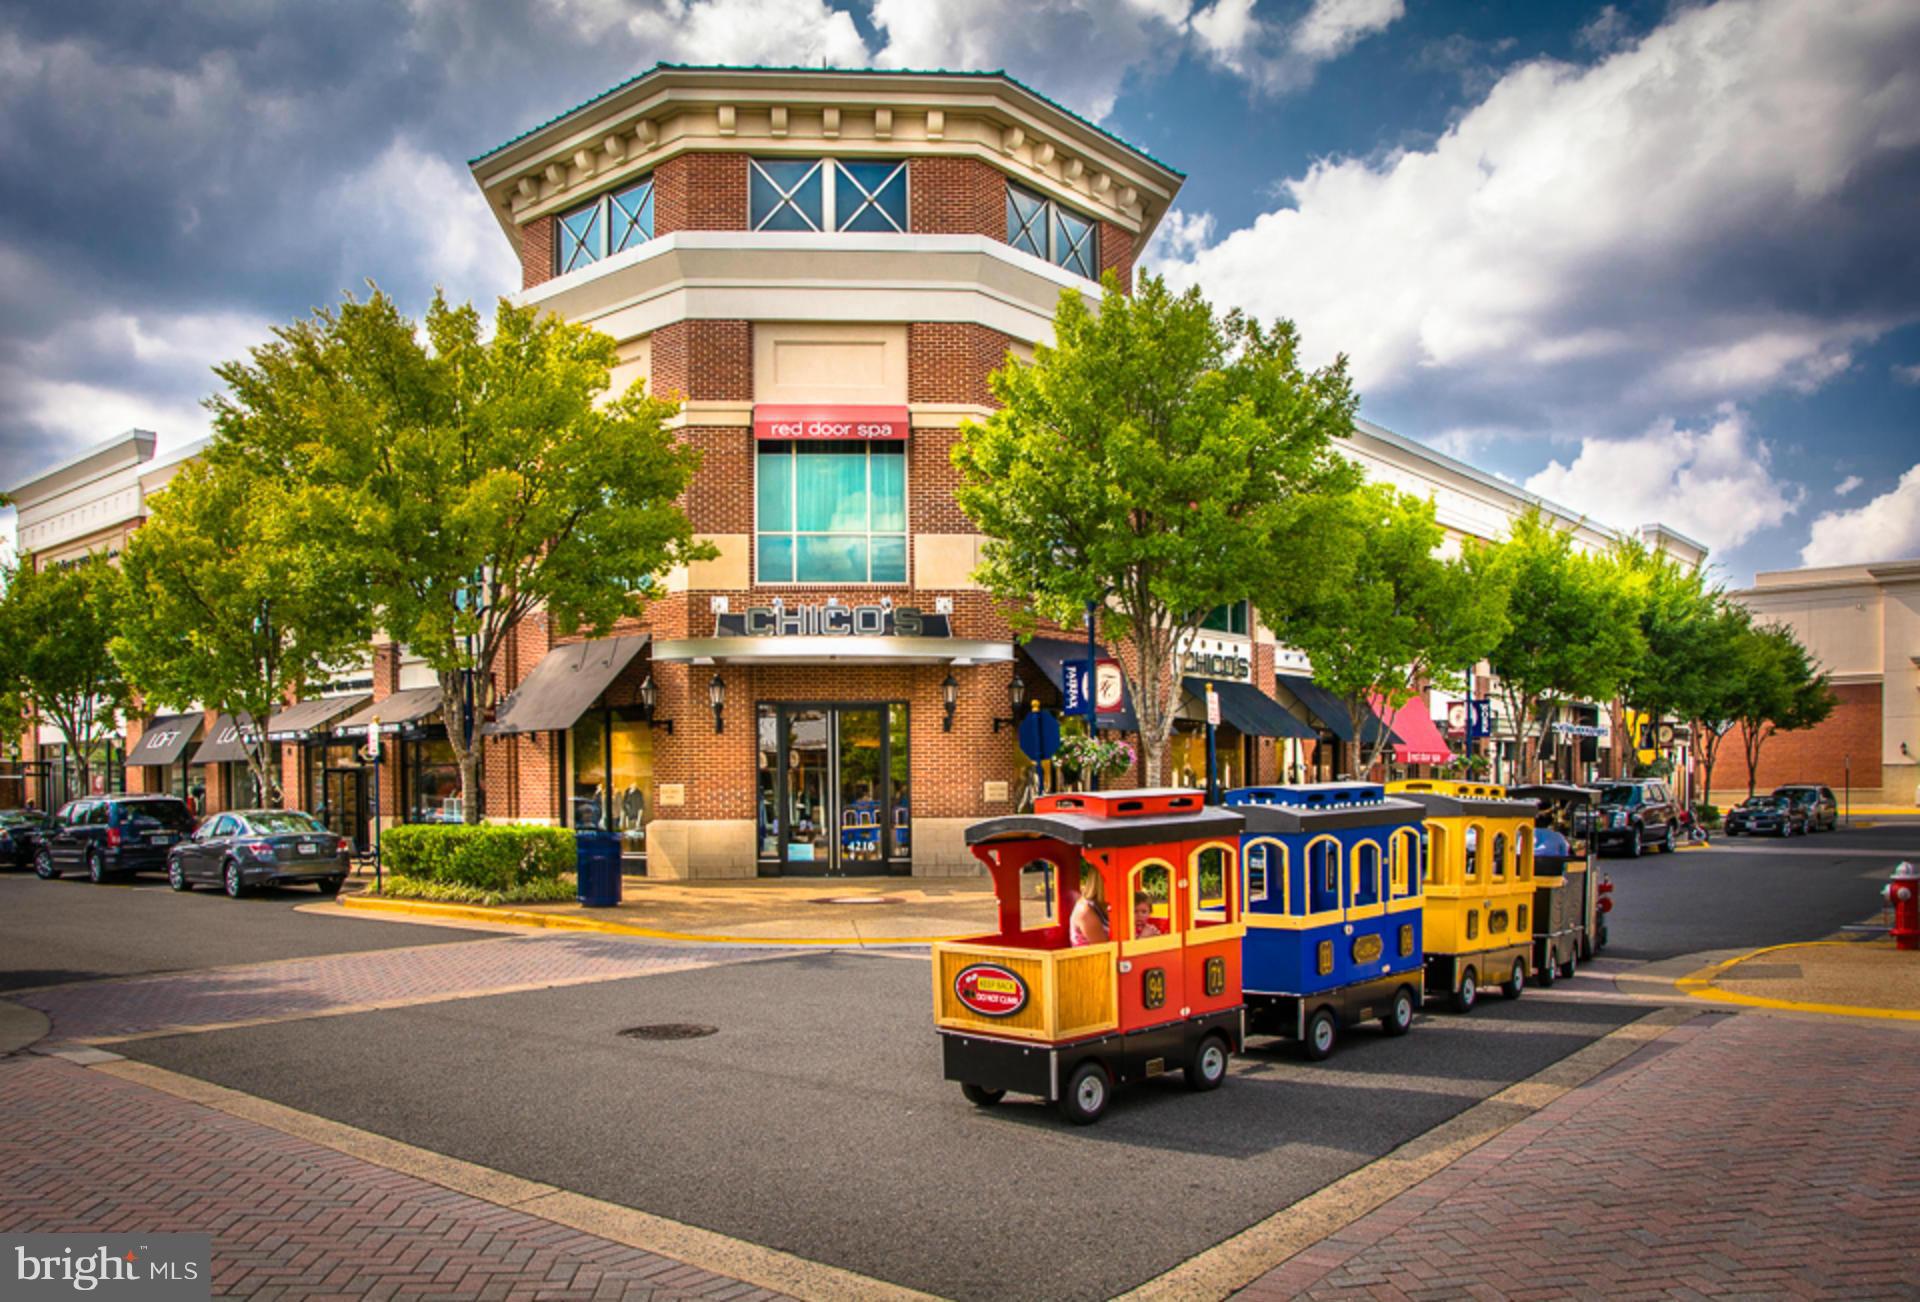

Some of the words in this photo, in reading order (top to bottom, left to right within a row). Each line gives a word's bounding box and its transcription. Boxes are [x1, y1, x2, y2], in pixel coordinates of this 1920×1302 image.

[771, 421, 803, 436] red
[808, 422, 852, 436] door
[857, 424, 893, 439] spa
[744, 604, 923, 637] CHICO'S
[146, 730, 181, 749] LOFT
[848, 841, 876, 852] 4216
